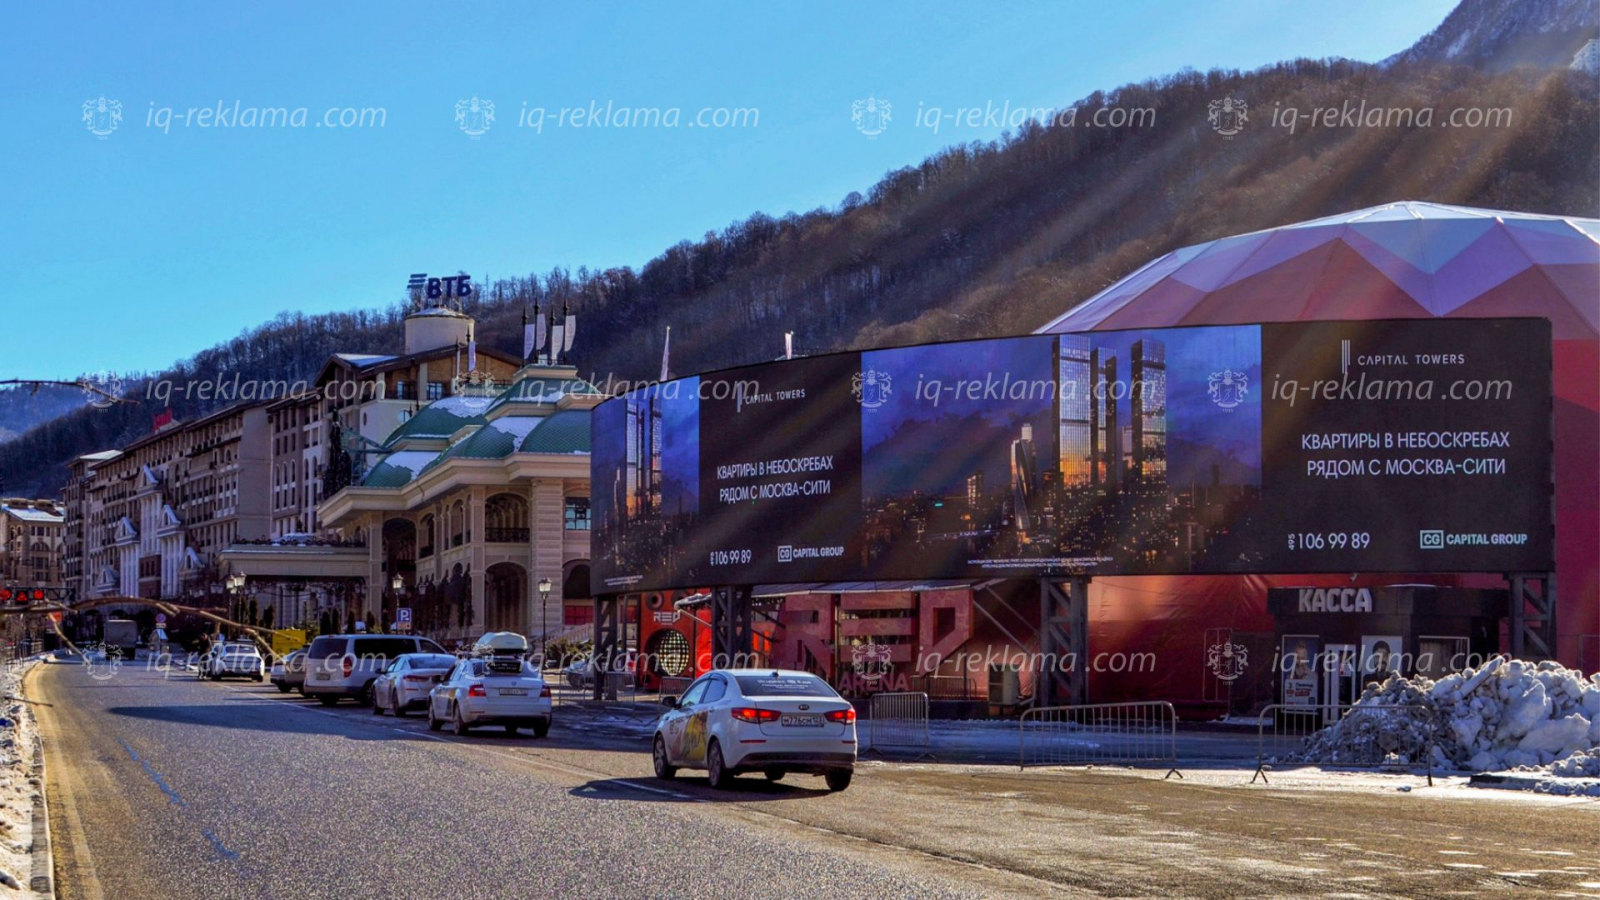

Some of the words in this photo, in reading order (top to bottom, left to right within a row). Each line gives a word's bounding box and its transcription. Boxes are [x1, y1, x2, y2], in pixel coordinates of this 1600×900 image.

[427, 274, 472, 299] ВТБ
[1357, 355, 1408, 366] CAPITAL
[1415, 354, 1465, 365] TOWERS
[745, 392, 773, 405] CAPITAL
[776, 388, 806, 401] TOWERS
[1301, 432, 1380, 450] КВАРТИРЫ
[1384, 432, 1393, 449] В
[1398, 431, 1510, 448] НЕБОСКРЕБАХ
[717, 462, 758, 480] КВАРТИРЫ
[759, 461, 765, 476] В
[766, 455, 834, 474] НЕБОСКРЕБАХ
[1307, 459, 1364, 479] РЯДОМ
[1368, 459, 1381, 476] С
[1385, 458, 1506, 475] МОСКВА-СИТИ
[720, 485, 749, 504] РЯДОМ
[750, 485, 758, 500] С
[760, 479, 831, 499] МОСКВА-СИТИ
[1287, 533, 1296, 550] 495
[1298, 532, 1325, 549] 106
[1328, 532, 1347, 549] 99
[1351, 532, 1370, 549] 89
[1446, 534, 1489, 545] CAPITAL
[1491, 533, 1528, 545] GROUP
[715, 550, 728, 565] 106
[729, 550, 740, 564] 99
[741, 549, 752, 563] 89
[793, 547, 820, 558] CAPITAL
[820, 546, 845, 557] GROUP
[1298, 587, 1373, 613] КАССА
[400, 609, 409, 621] P
[653, 611, 681, 623] RED
[773, 589, 974, 678] RED
[838, 671, 910, 692] ARENA
